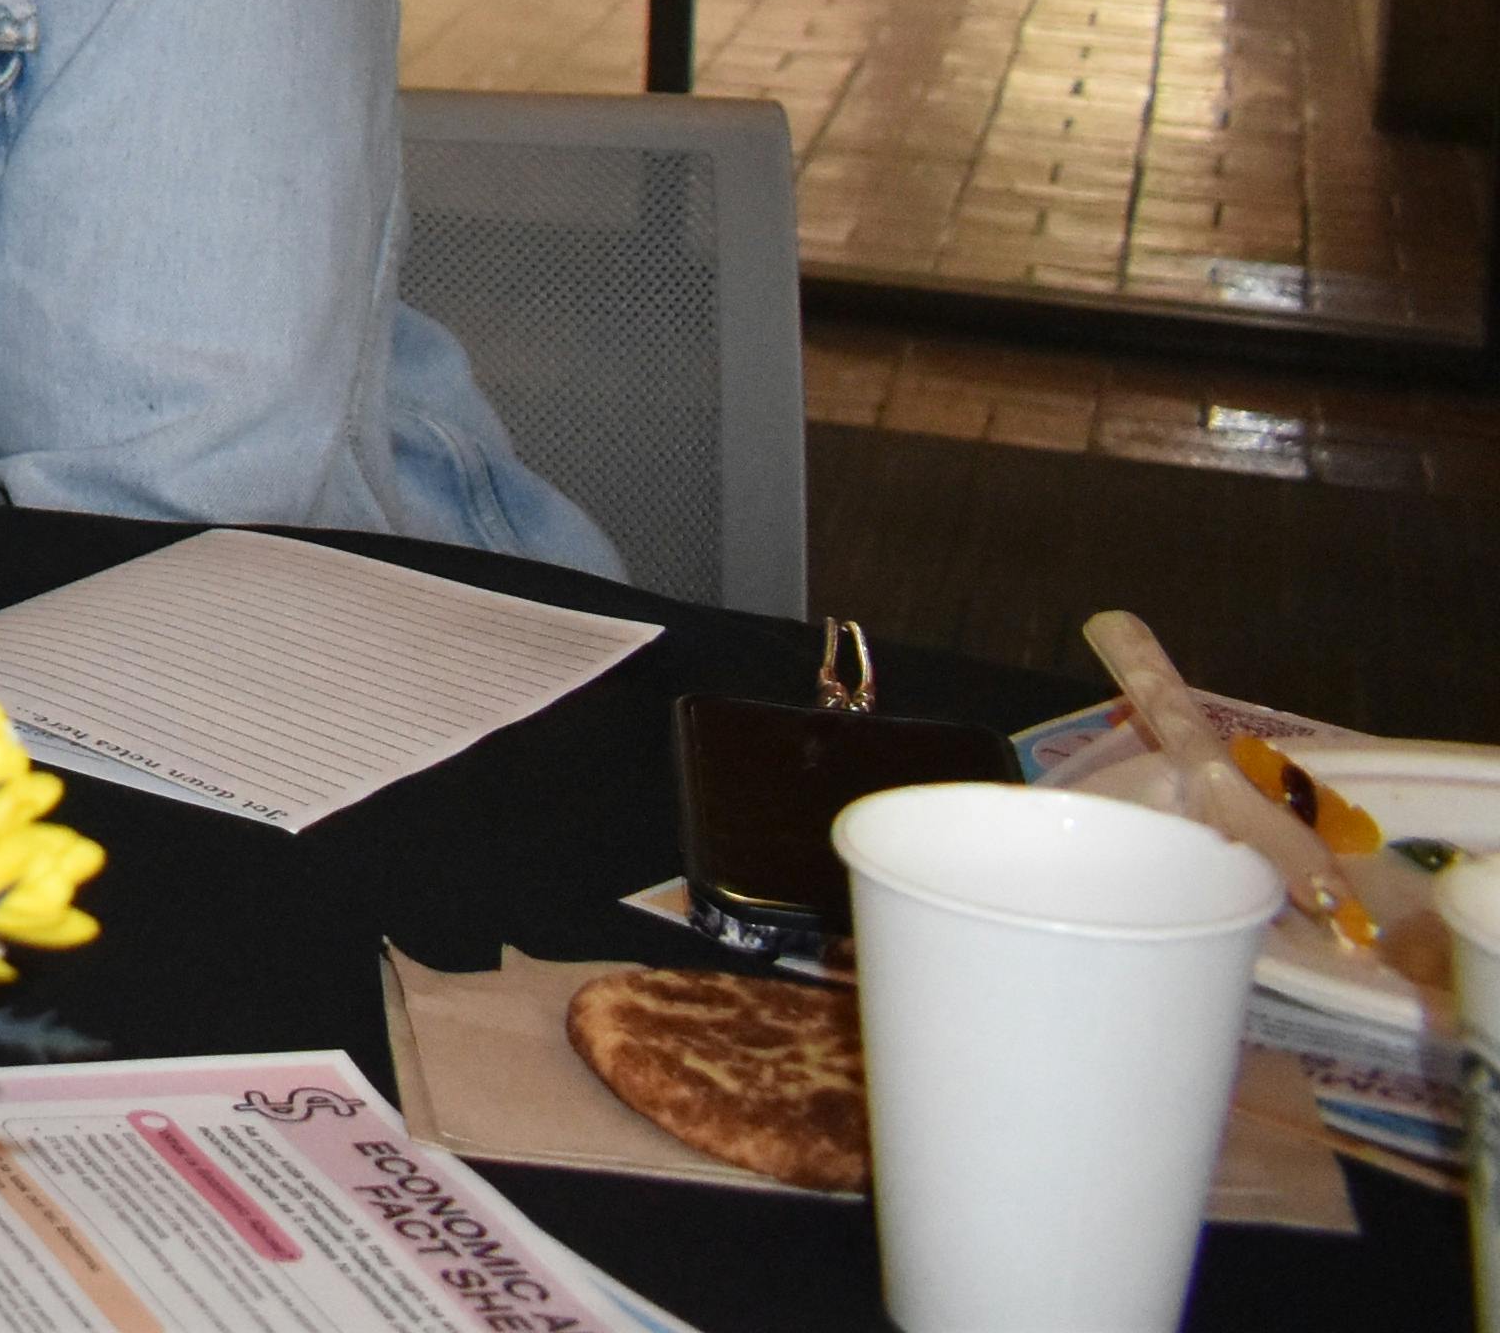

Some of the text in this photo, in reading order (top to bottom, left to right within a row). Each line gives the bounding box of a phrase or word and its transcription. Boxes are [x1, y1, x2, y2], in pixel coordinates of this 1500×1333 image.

[96, 739, 161, 770] notes
[168, 768, 235, 800] down
[353, 1140, 549, 1302] ECONOMIC
[353, 1184, 461, 1259] FACT
